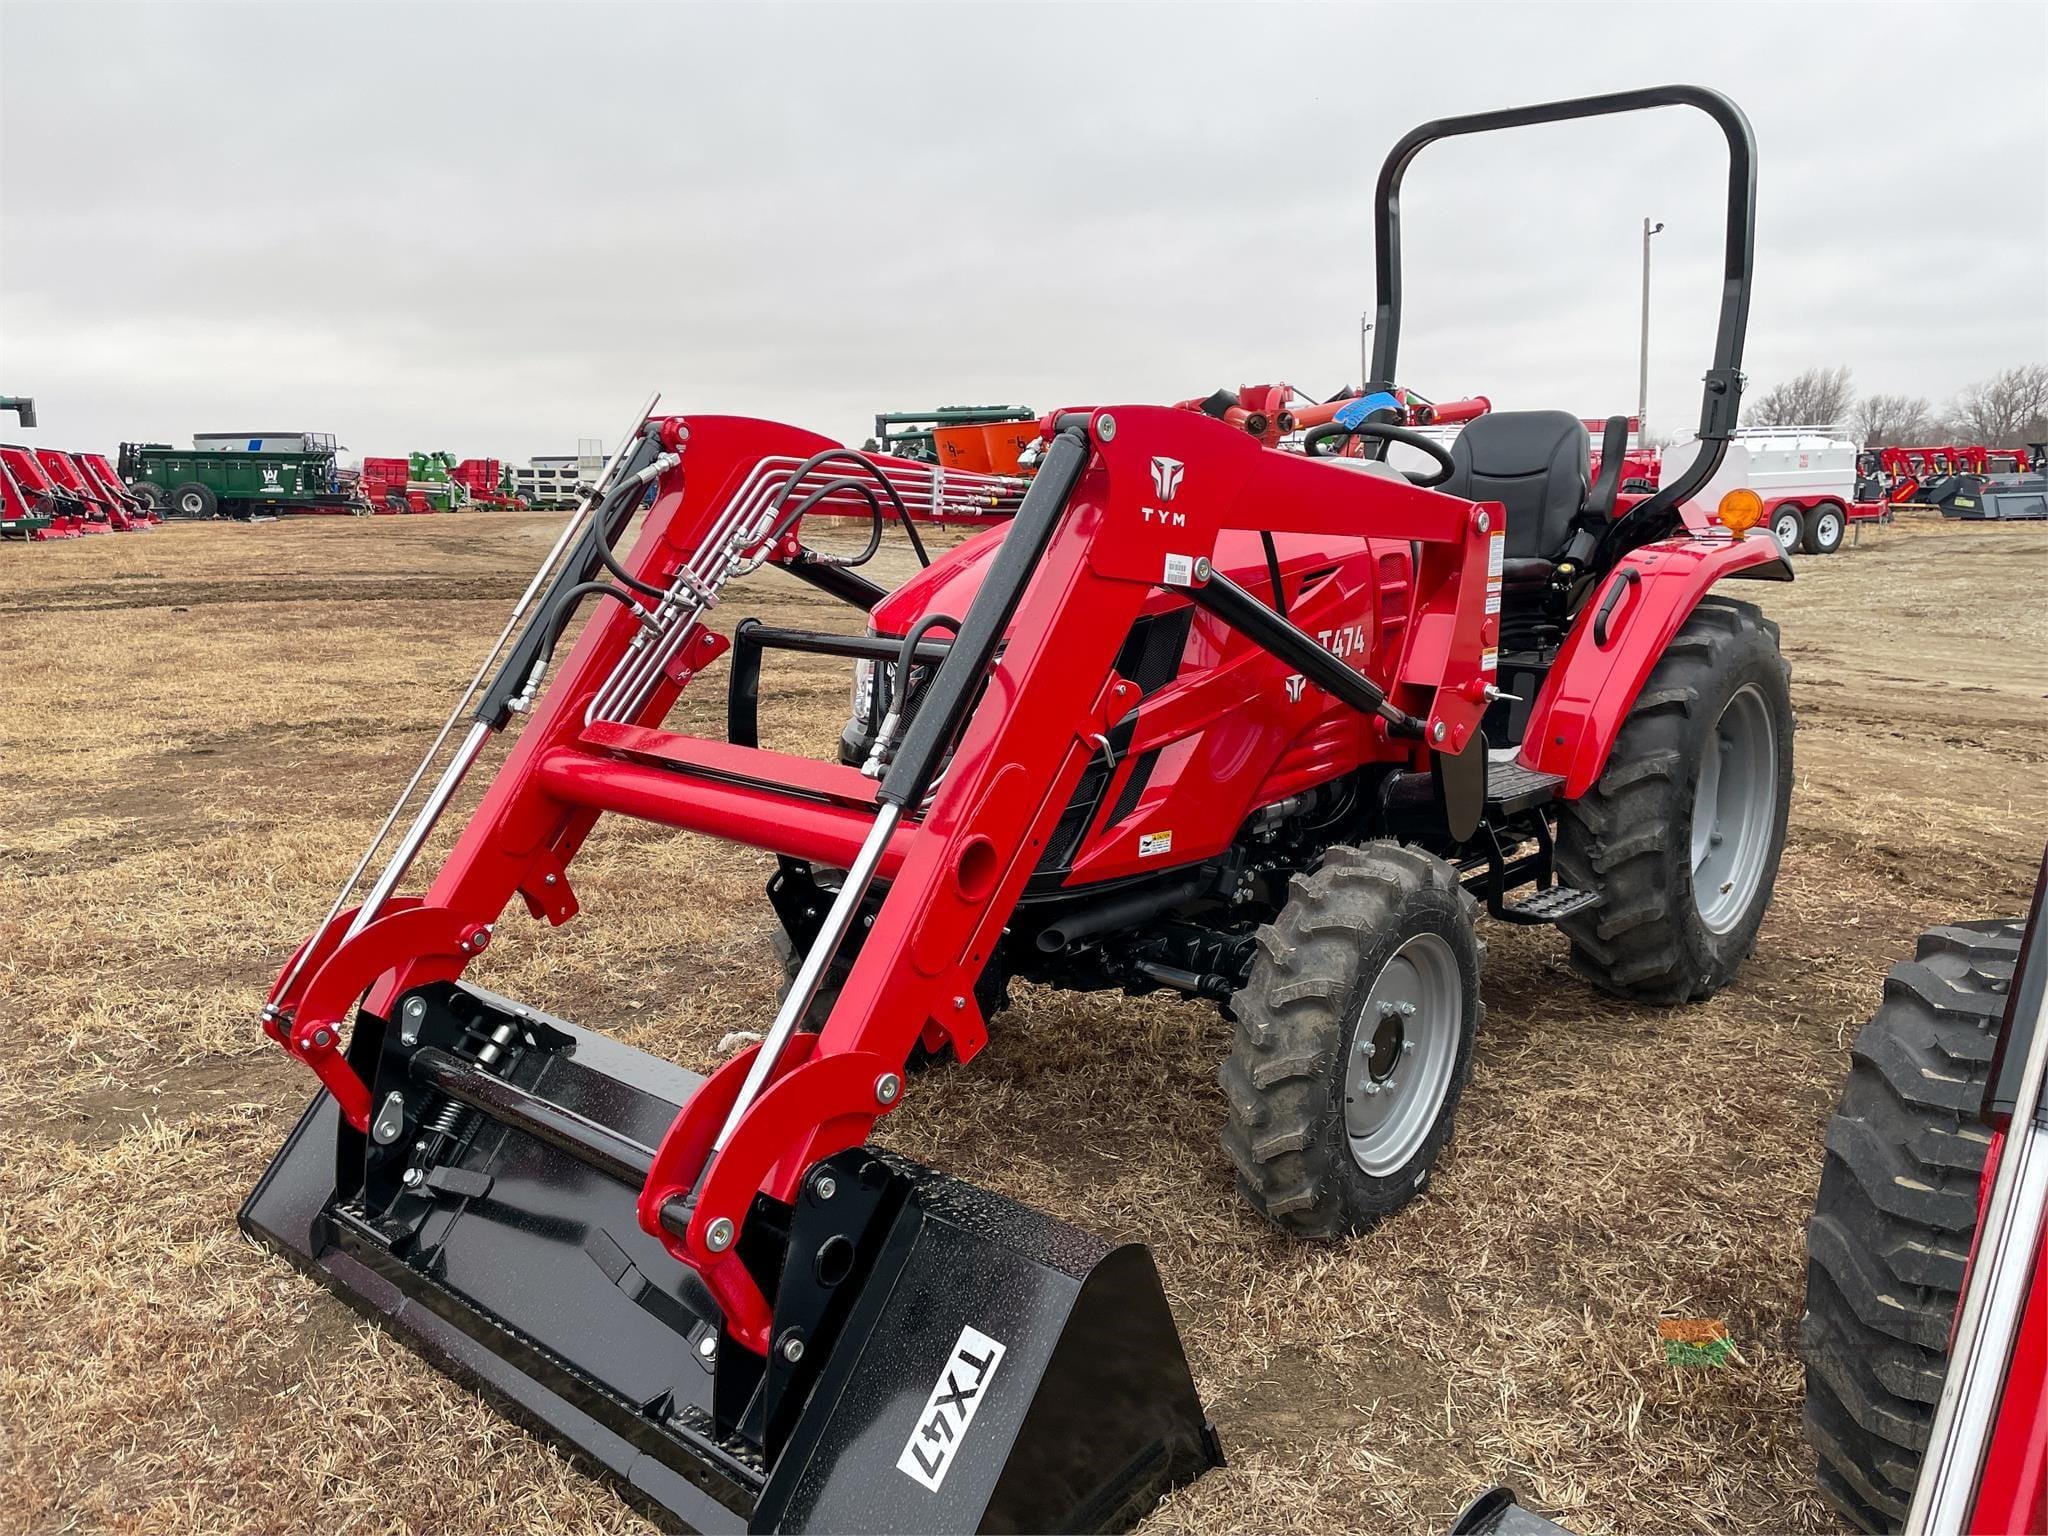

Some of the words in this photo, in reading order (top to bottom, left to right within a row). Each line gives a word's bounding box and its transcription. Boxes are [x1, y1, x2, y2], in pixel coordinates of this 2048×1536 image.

[1141, 507, 1186, 527] TYM
[1318, 625, 1365, 658] T474
[911, 1349, 996, 1480] TX47
